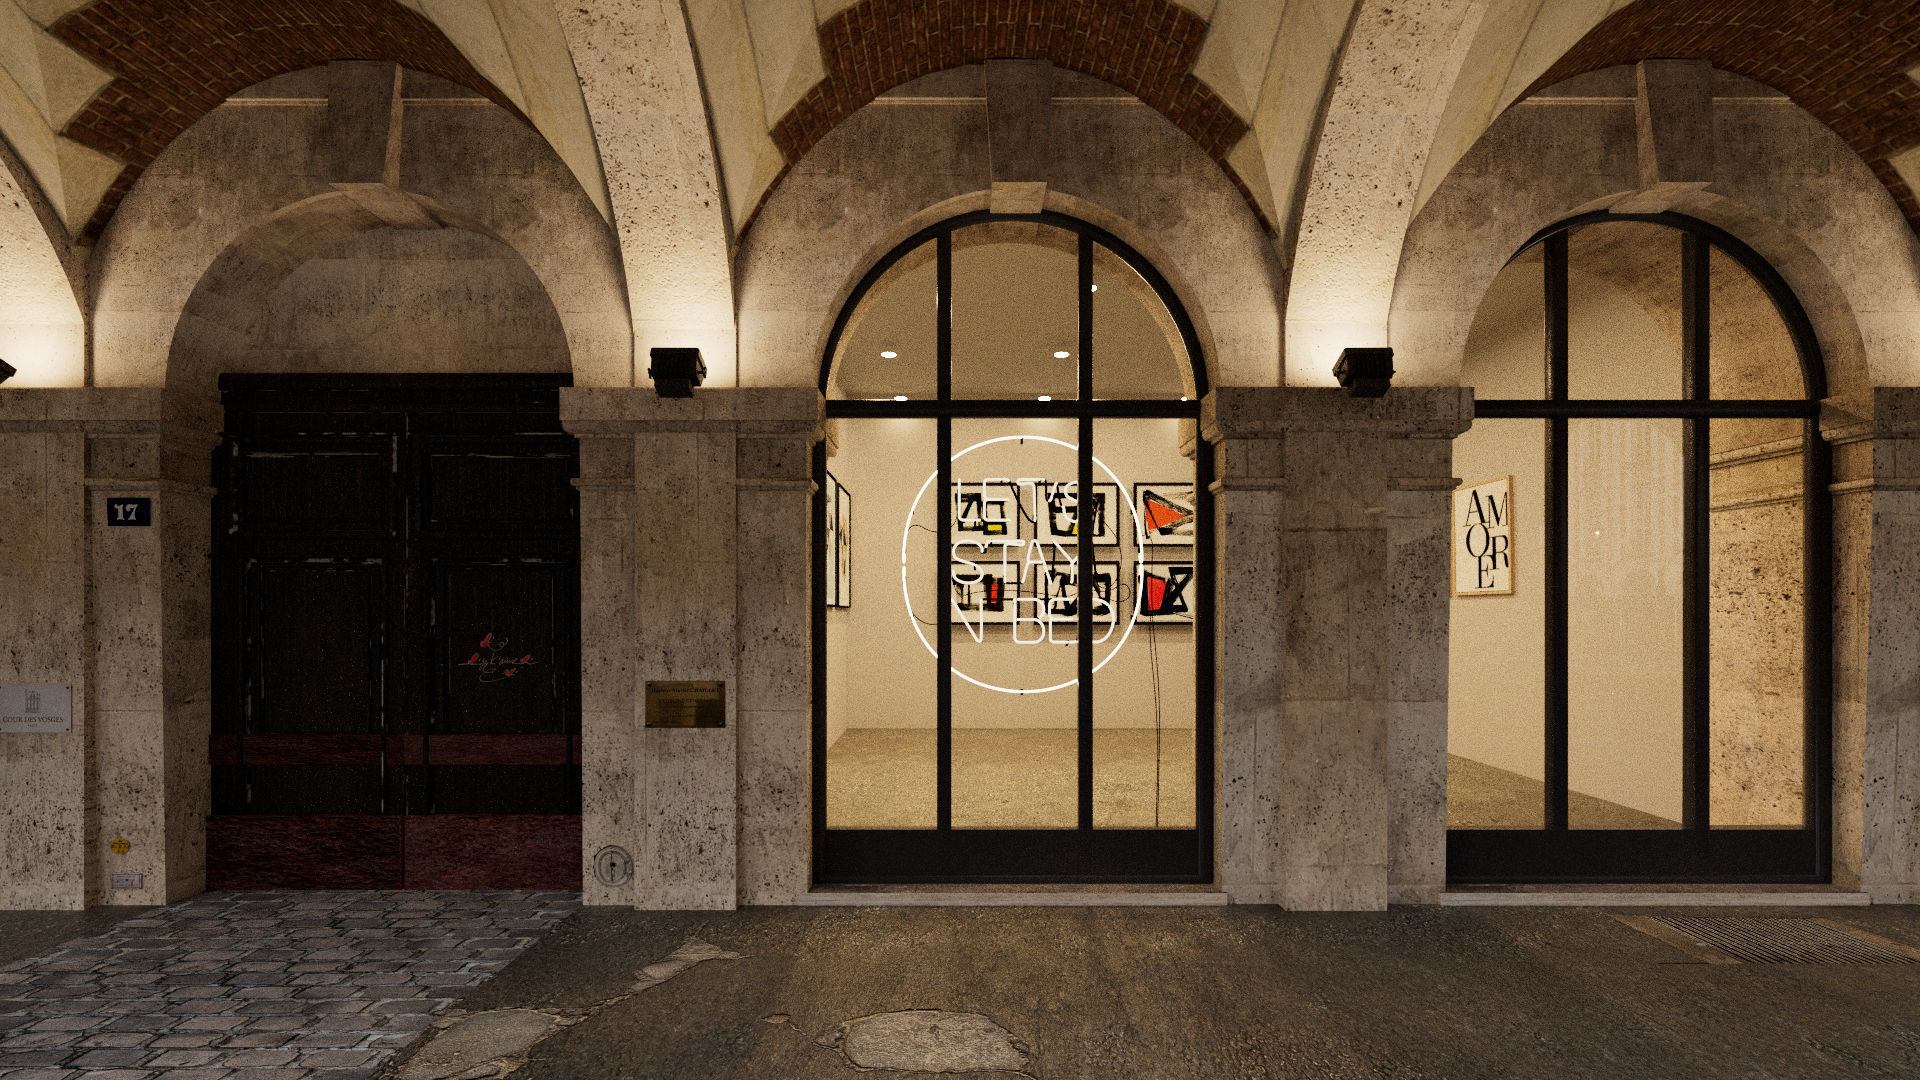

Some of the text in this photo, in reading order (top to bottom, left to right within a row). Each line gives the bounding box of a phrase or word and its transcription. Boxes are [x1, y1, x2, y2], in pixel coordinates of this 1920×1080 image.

[113, 503, 139, 521] 17
[951, 538, 1079, 585] STAY
[1012, 597, 1116, 645] BED
[2, 715, 64, 723] COUR DES VOSGES
